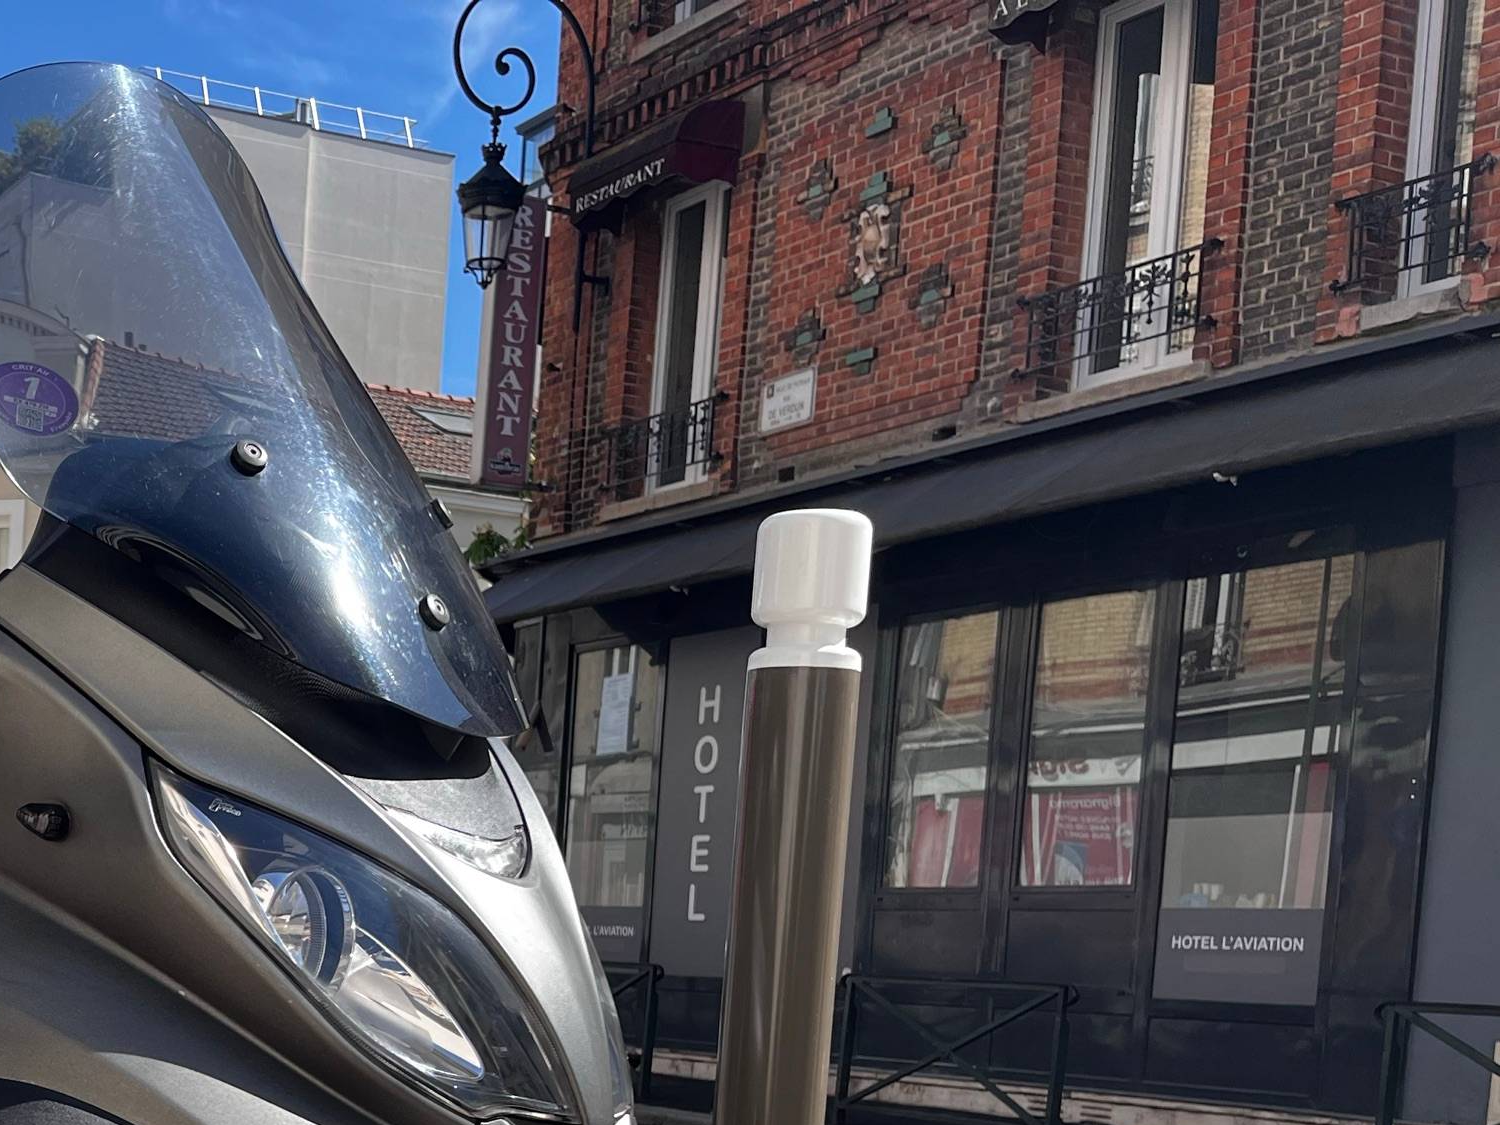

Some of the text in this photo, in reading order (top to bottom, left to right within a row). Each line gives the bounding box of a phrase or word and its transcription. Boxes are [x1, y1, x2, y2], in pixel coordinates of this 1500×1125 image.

[576, 158, 665, 213] RESTAURANT
[494, 205, 535, 437] RESTAURANT
[24, 376, 40, 400] 1
[687, 684, 721, 921] HOTEL
[593, 925, 634, 937] L'AVIATION
[1171, 934, 1305, 952] HOTEL L'AVIATION
